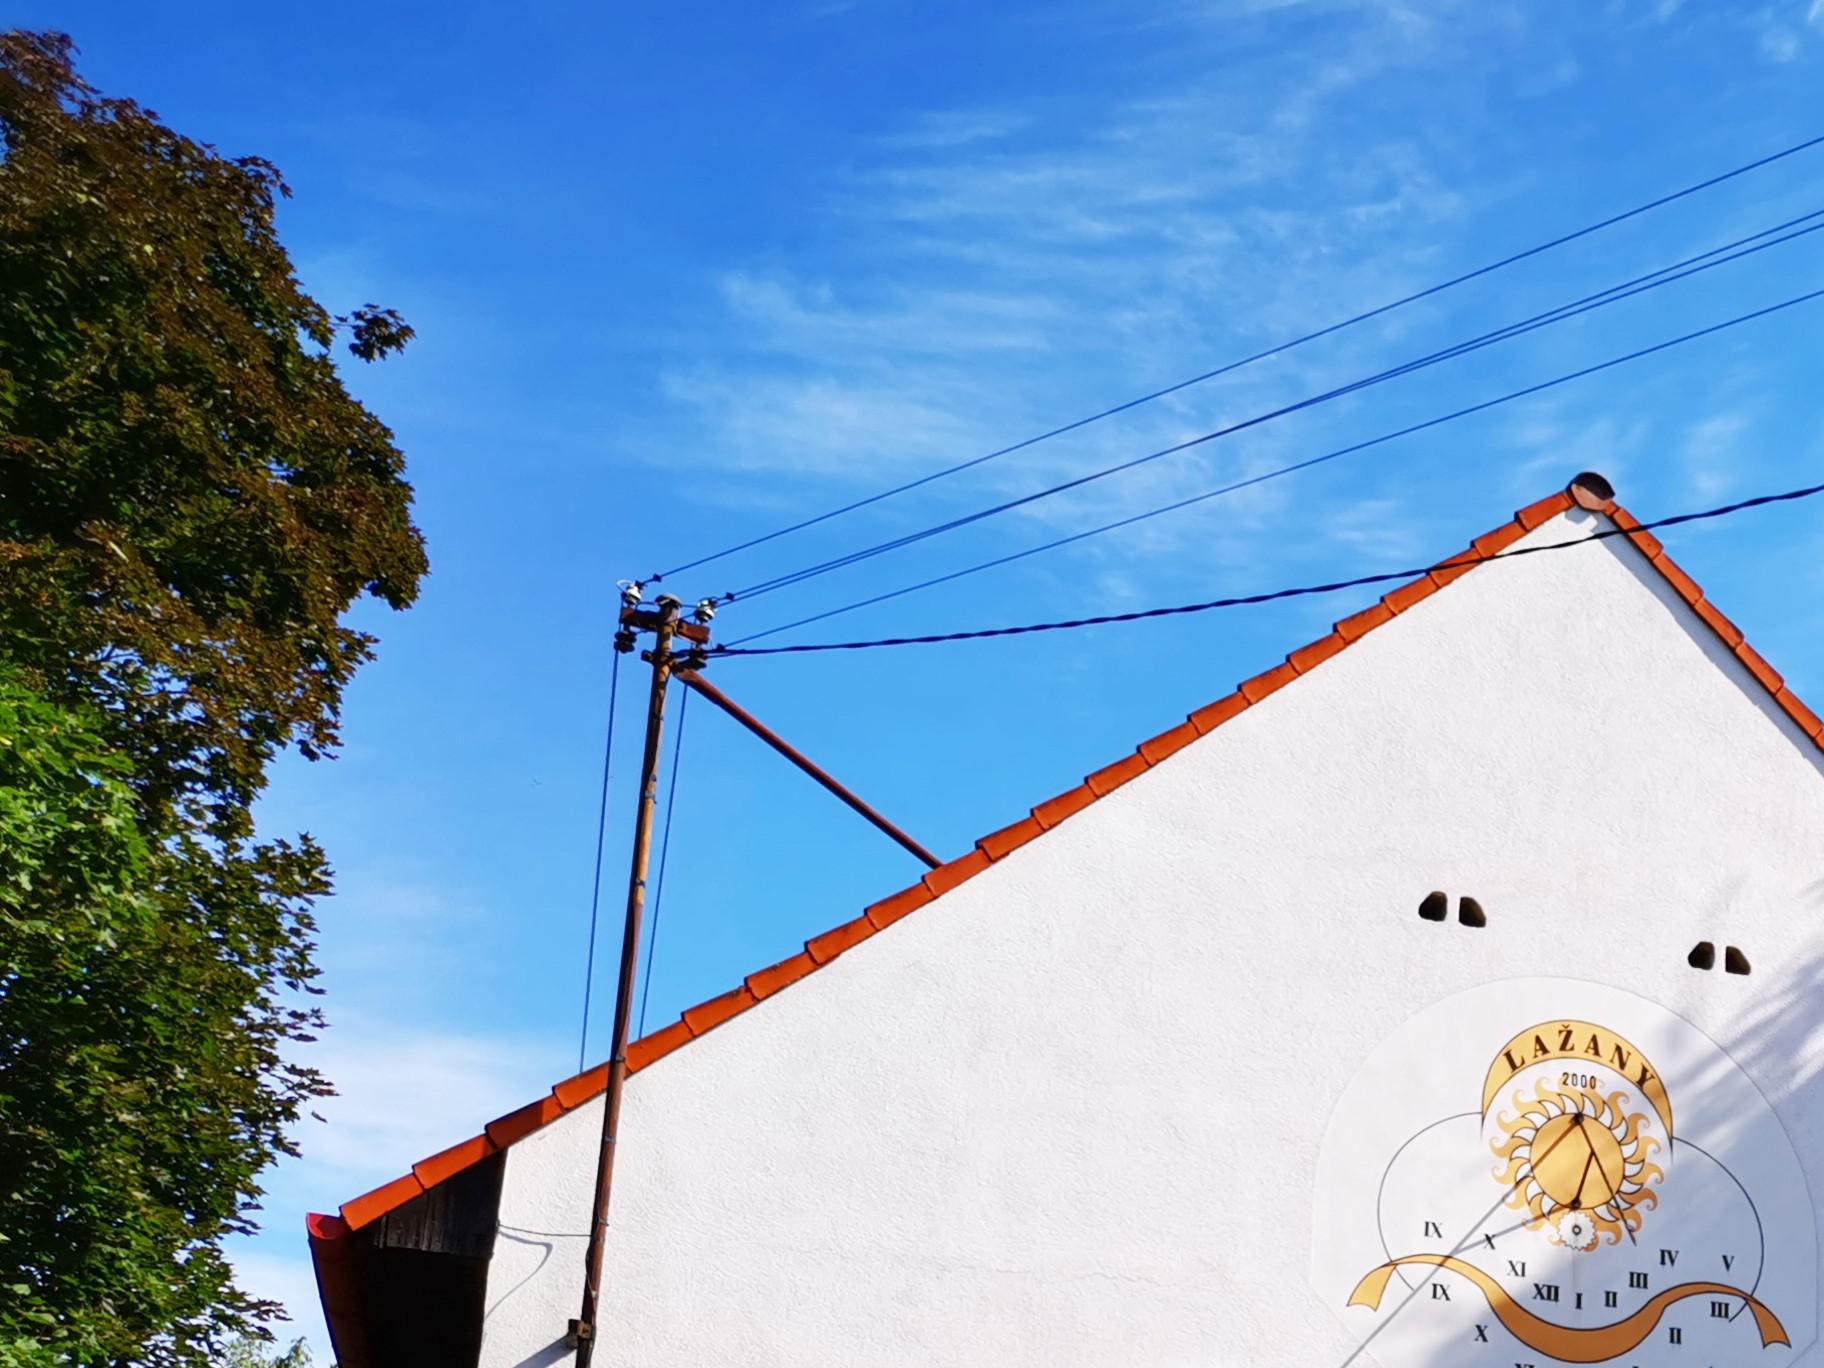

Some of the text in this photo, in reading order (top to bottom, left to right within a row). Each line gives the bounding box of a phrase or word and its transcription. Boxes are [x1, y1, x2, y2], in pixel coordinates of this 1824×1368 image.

[1503, 1024, 1655, 1091] LAŽANY
[1562, 1072, 1597, 1090] 2000
[1424, 1221, 1735, 1310] IX X XI XII I II III IV V
[1431, 1283, 1451, 1301] IX
[1474, 1324, 1489, 1342] X
[1669, 1327, 1682, 1345] II
[1710, 1301, 1730, 1319] III
